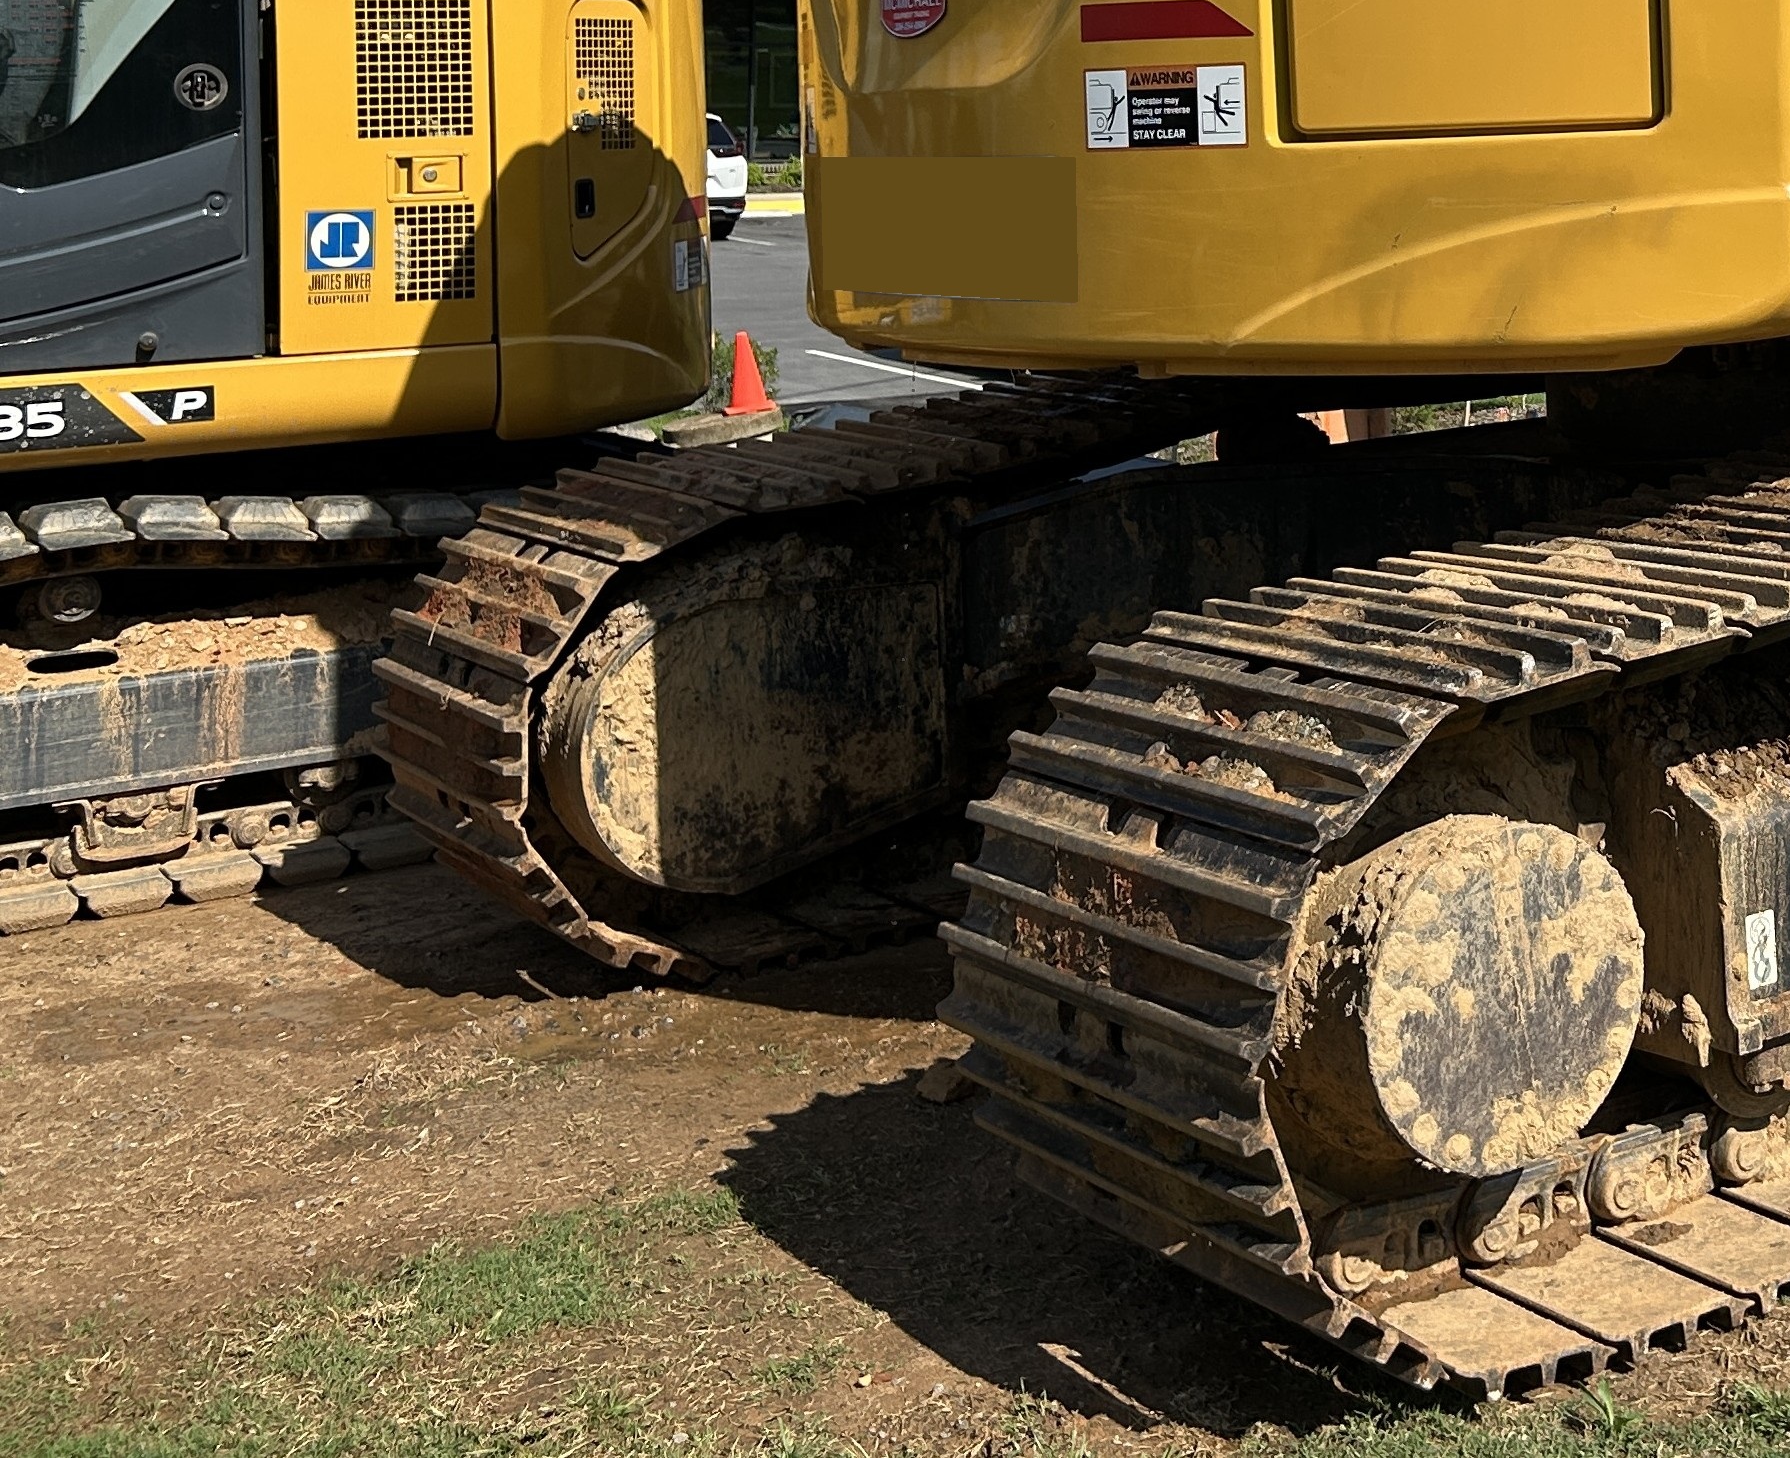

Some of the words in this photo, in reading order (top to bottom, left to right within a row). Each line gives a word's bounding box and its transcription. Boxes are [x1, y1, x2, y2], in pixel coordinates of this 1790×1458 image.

[1140, 70, 1194, 86] WARNING
[1163, 106, 1191, 115] reverse
[1133, 129, 1155, 140] STAY
[1156, 128, 1187, 139] CLEAR
[307, 274, 342, 291] JAMES
[344, 272, 372, 290] RIVER
[307, 293, 370, 306] EQUIPMENT
[170, 390, 208, 421] P
